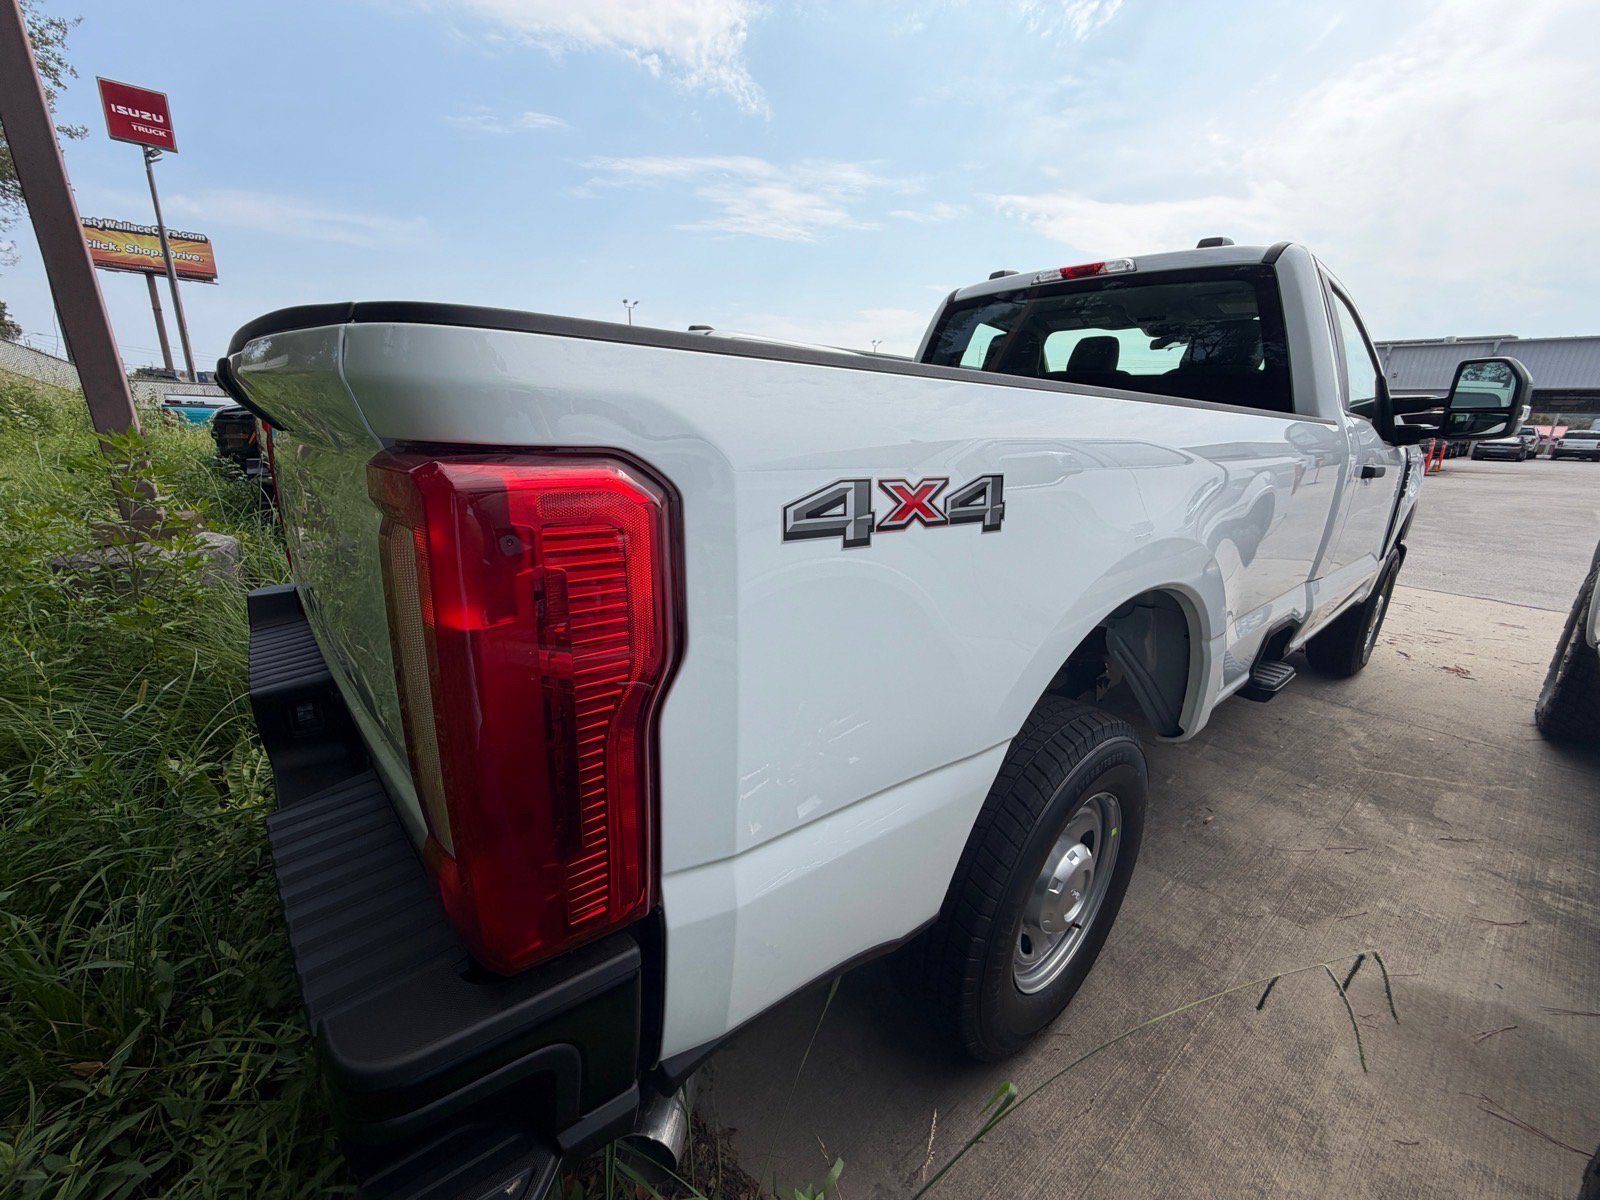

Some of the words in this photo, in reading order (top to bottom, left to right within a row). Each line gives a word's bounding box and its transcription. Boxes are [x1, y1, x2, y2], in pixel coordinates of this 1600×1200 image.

[111, 103, 164, 124] ISUZU
[131, 124, 168, 138] TRUCK
[125, 244, 163, 257] Shop.
